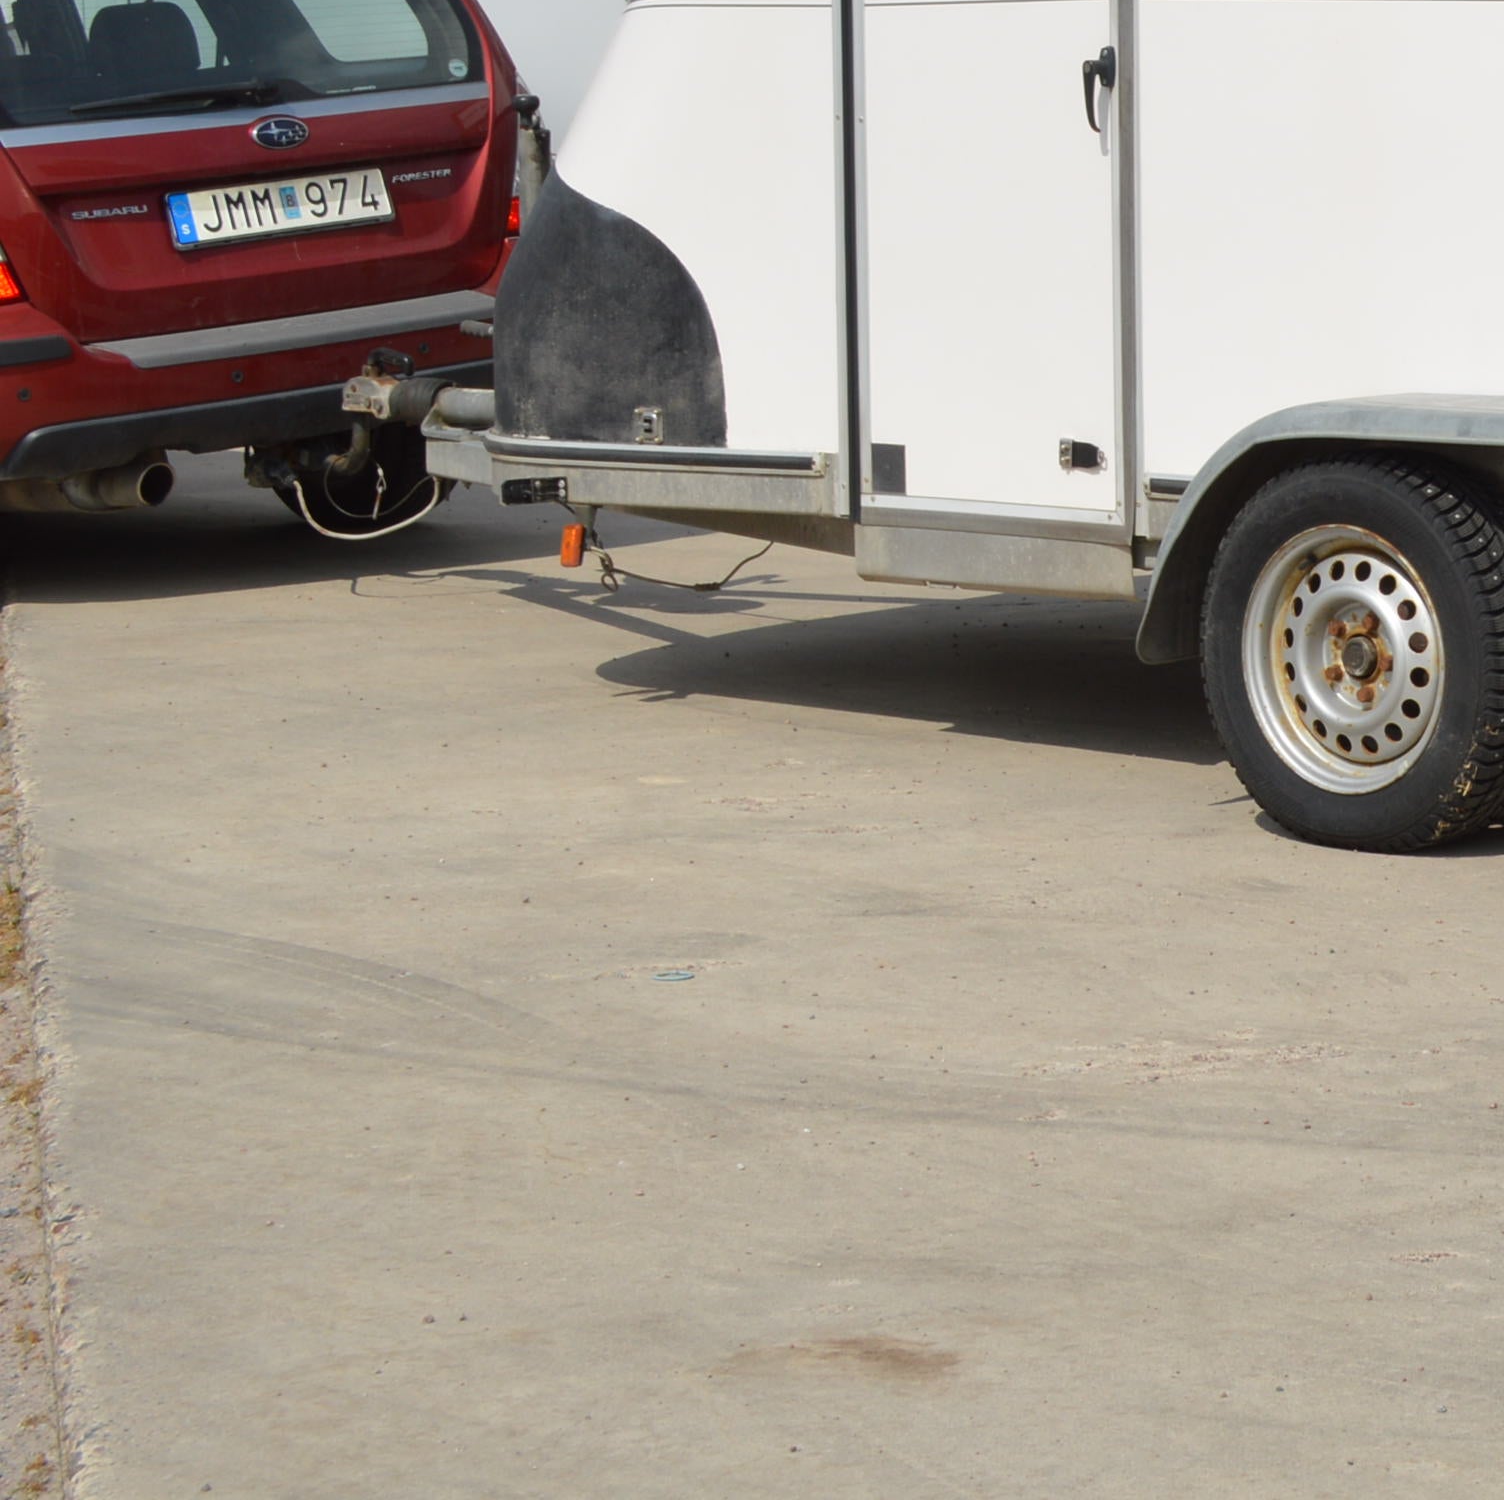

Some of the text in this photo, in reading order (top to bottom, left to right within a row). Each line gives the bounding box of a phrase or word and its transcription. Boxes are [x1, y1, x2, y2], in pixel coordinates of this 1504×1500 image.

[391, 168, 451, 184] FORESTER
[203, 174, 380, 233] JMM 974
[71, 204, 148, 220] SUBARU
[181, 224, 191, 236] S
